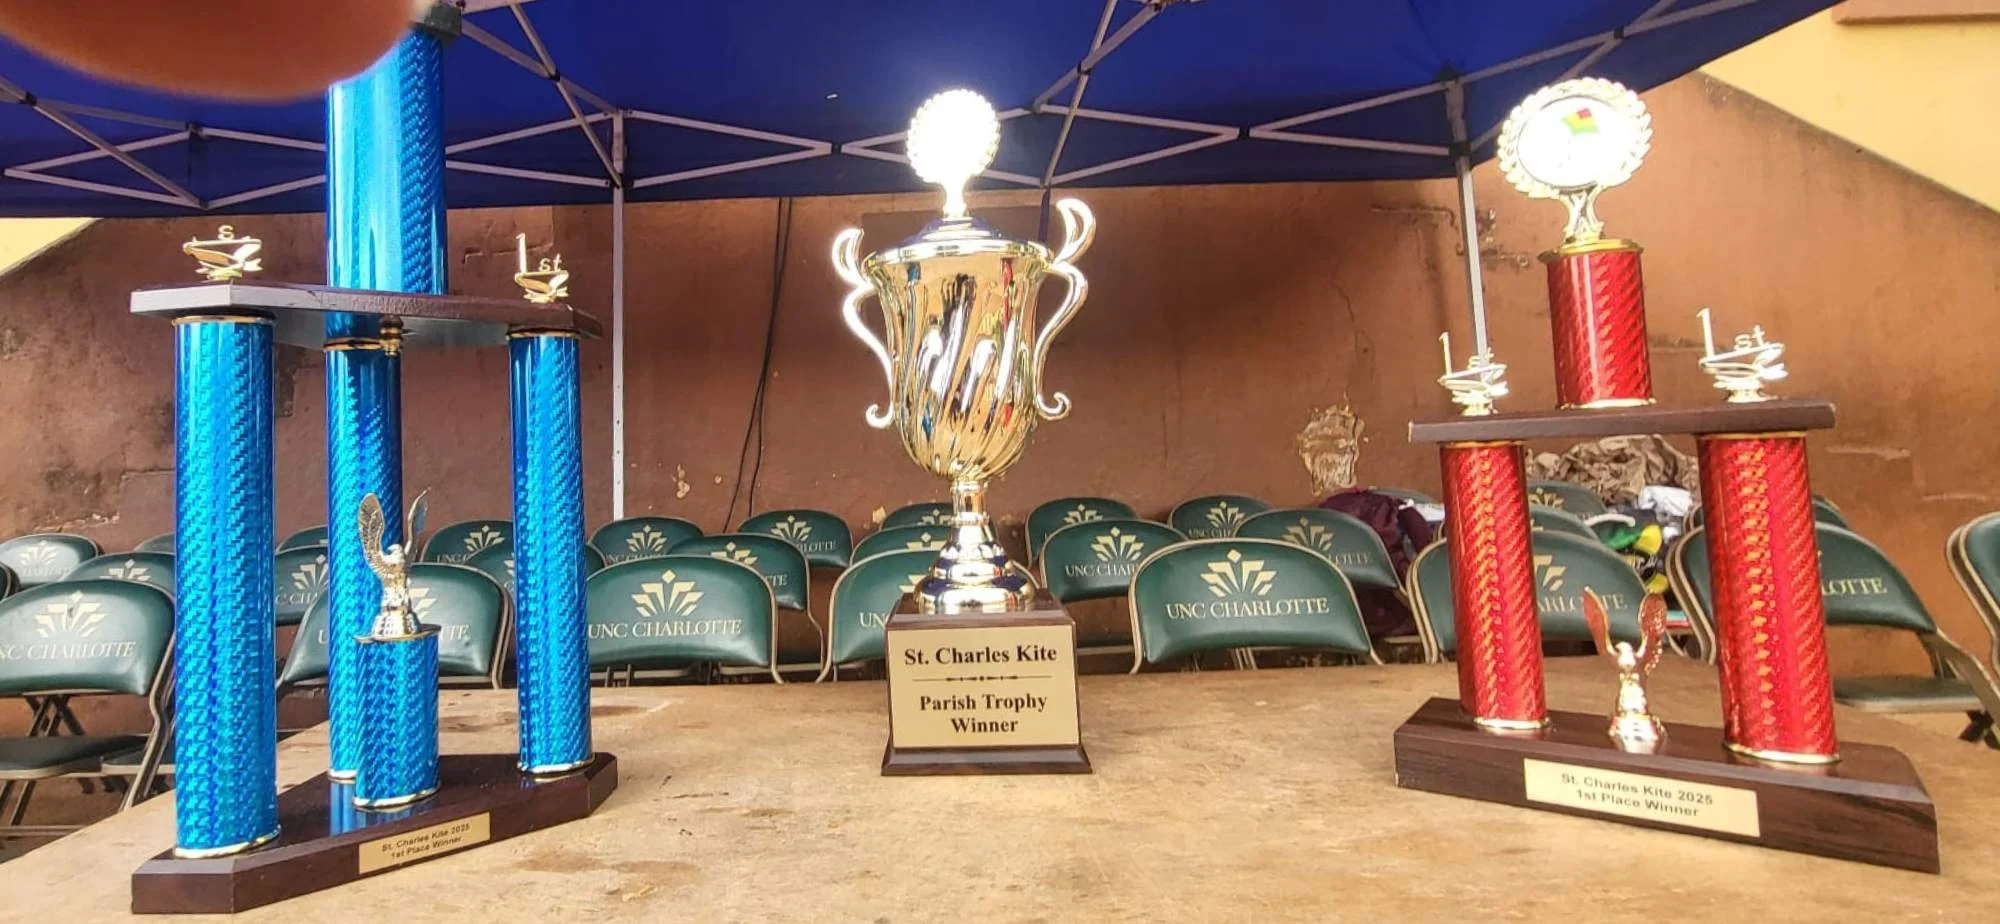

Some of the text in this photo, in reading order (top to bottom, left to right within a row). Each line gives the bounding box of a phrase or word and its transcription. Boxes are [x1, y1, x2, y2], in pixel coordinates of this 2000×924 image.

[515, 232, 562, 273] 1st
[1696, 307, 1765, 358] 1st
[1065, 564, 1096, 577] UNC
[1821, 577, 1887, 597] LOTTE
[1165, 597, 1330, 620] UNC CHARLOTTE
[587, 619, 744, 639] UNC CHARLOTTE
[859, 612, 887, 628] UN
[27, 641, 137, 660] CHARLOTTE
[904, 645, 1057, 666] St. Charles Kite
[920, 693, 1048, 713] Parish Trophy
[951, 717, 1019, 733] Winner
[1561, 773, 1714, 805] St. Charles Kite 2025
[1577, 788, 1700, 817] 1st Place Winner
[396, 834, 429, 847] Charles
[431, 830, 449, 839] Kite
[451, 824, 470, 834] 2025
[391, 837, 461, 859] 1st Place Winner
